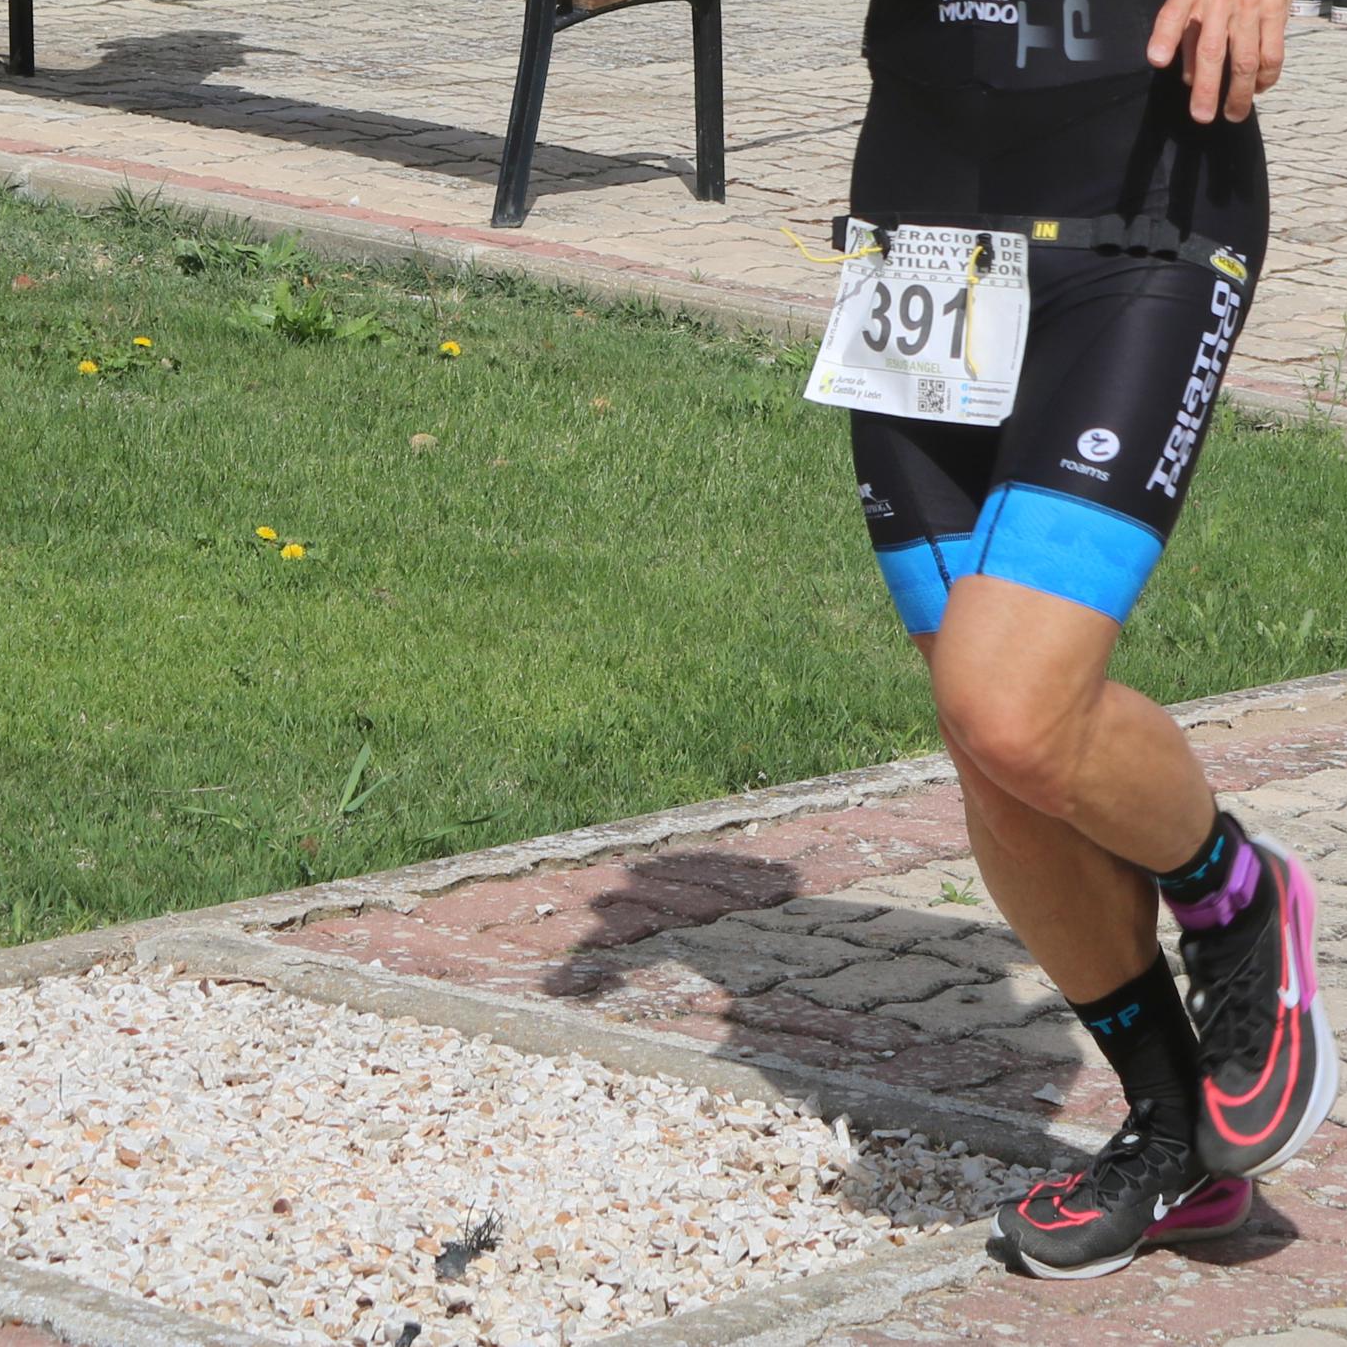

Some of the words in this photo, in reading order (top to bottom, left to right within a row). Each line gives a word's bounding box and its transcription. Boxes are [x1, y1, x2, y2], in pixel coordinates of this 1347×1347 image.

[938, 1, 1020, 25] MUNDO
[1035, 223, 1057, 239] IN
[1000, 237, 1023, 249] DE
[1002, 252, 1023, 263] DE
[861, 281, 969, 360] 391
[909, 360, 942, 374] ANGEL
[1145, 249, 1233, 491] TRIATLO
[1059, 458, 1111, 483] roams
